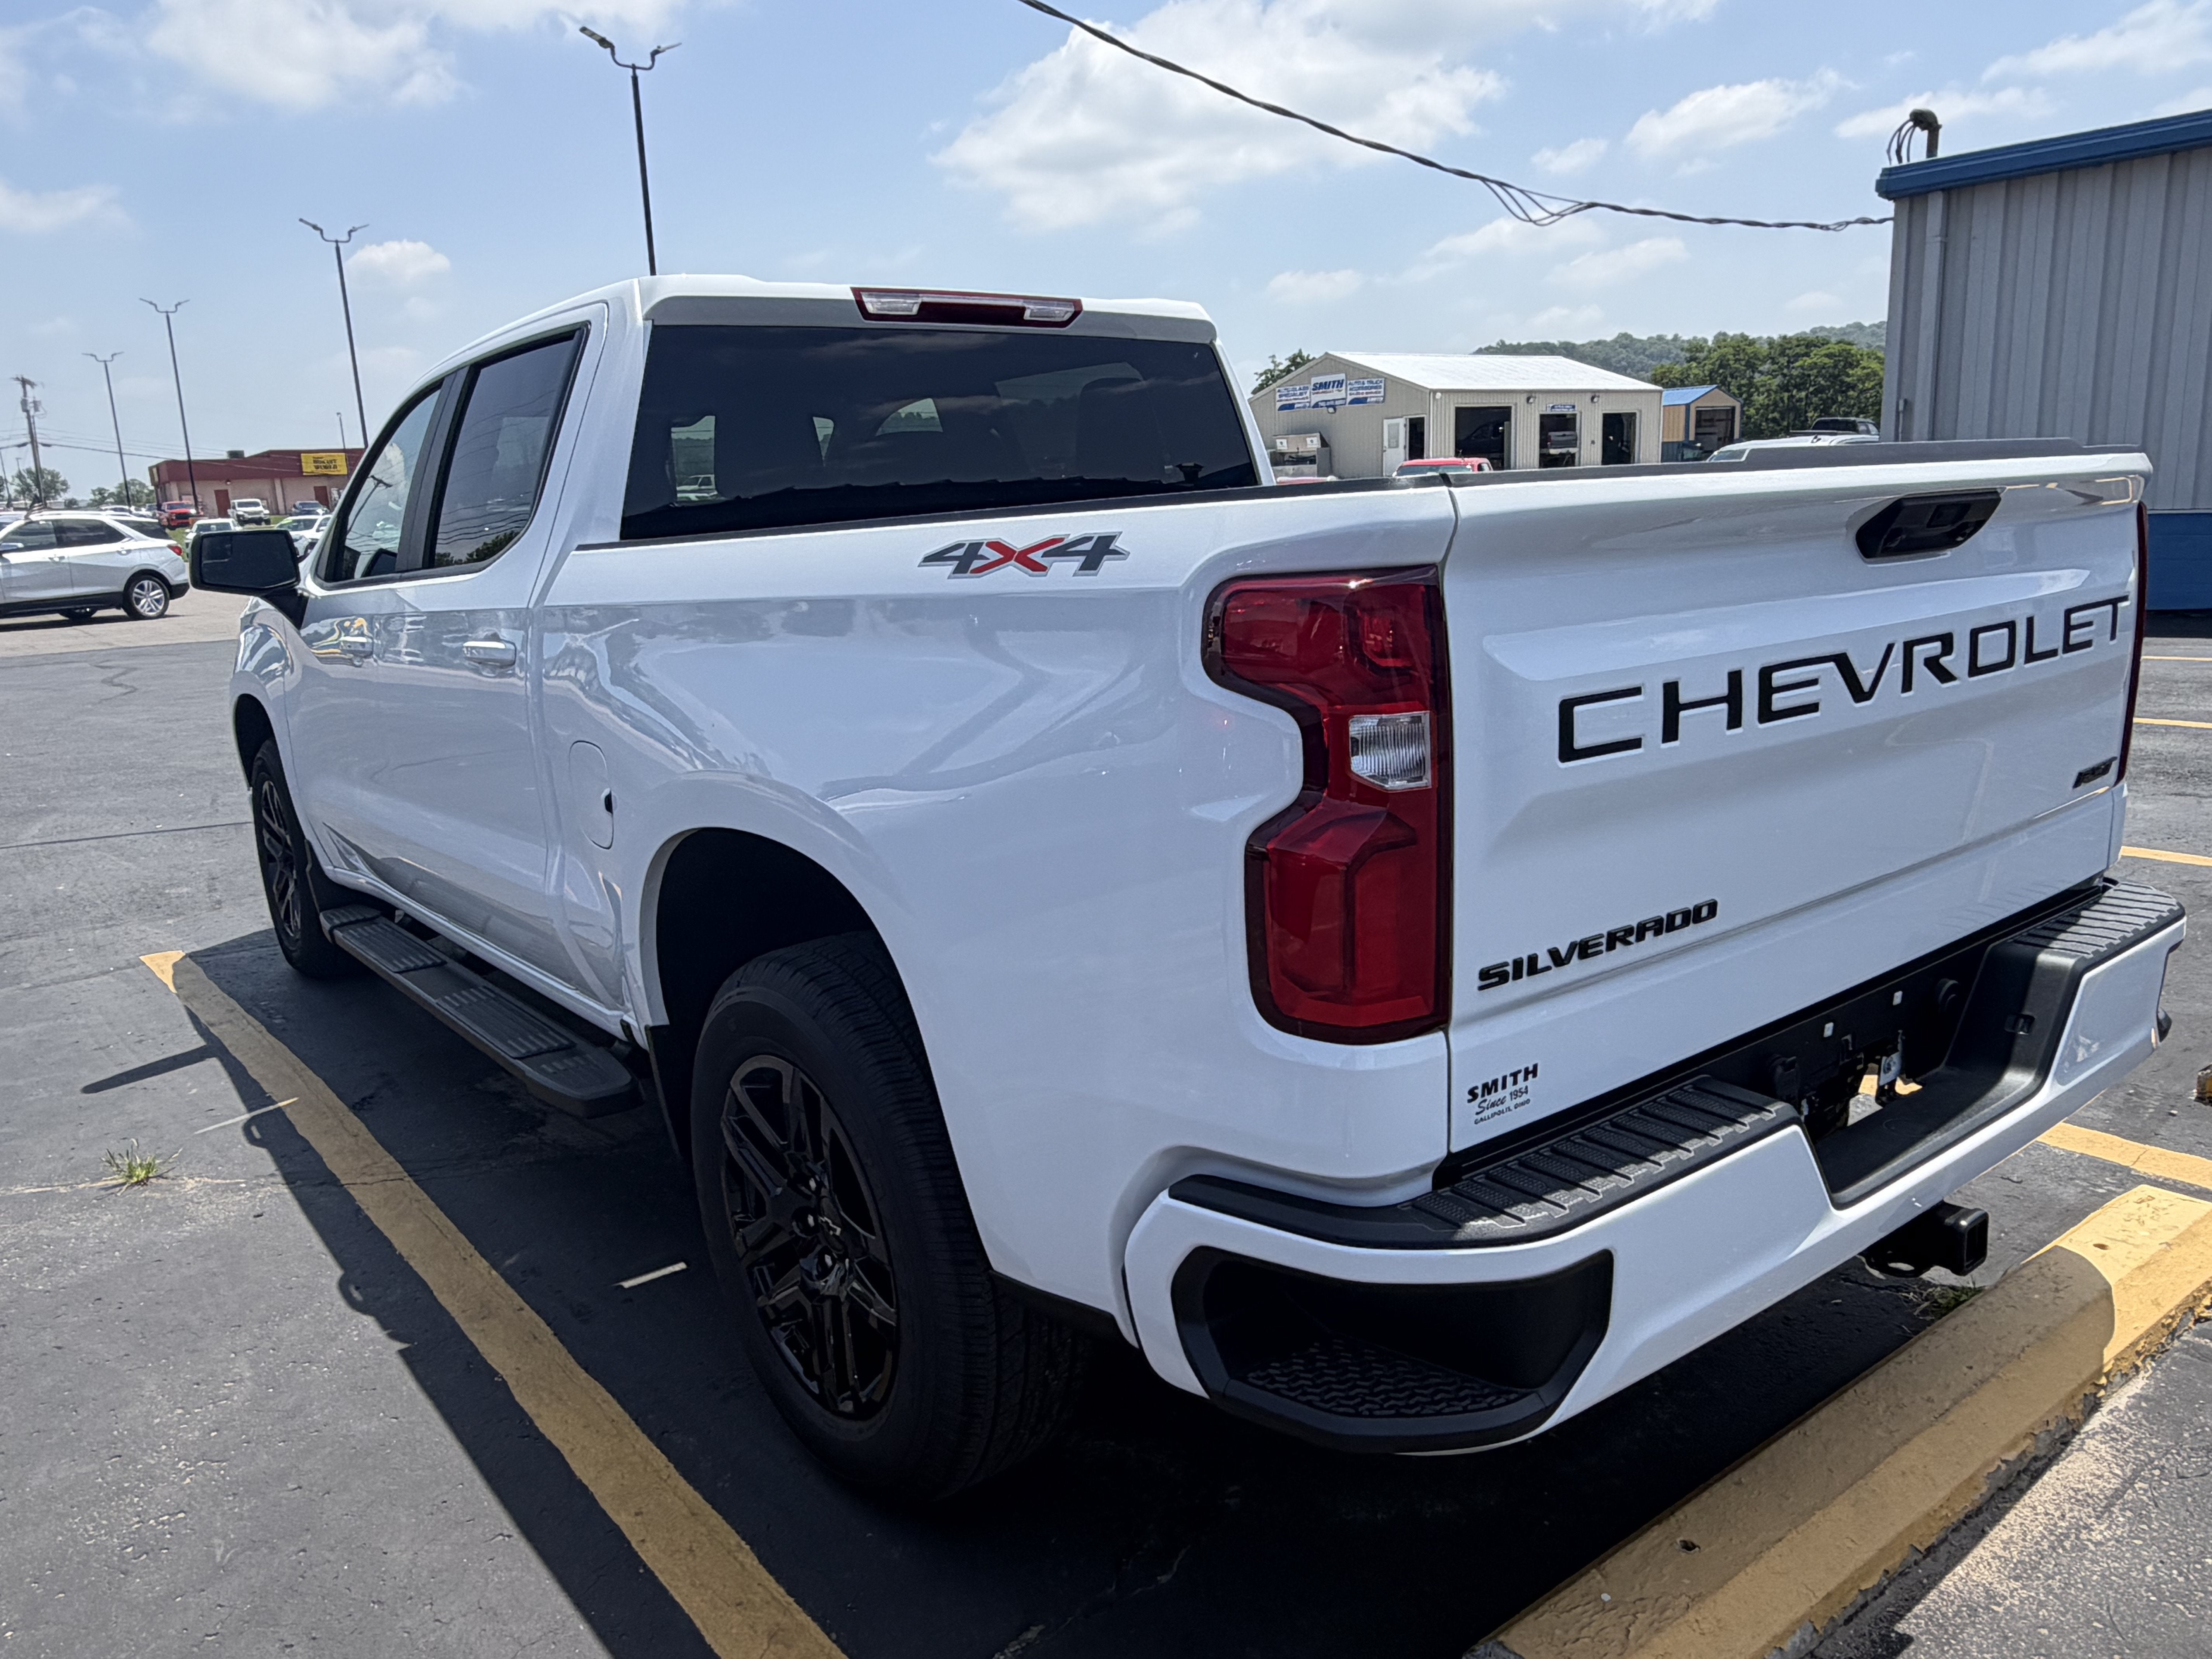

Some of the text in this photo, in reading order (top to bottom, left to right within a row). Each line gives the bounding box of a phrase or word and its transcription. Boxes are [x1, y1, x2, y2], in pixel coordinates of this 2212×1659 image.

[1312, 379, 1345, 391] SMITH
[917, 531, 1130, 579] 4X4
[1558, 595, 2130, 764] CHEVROLET
[1478, 899, 1718, 991] SILVERADO
[1467, 1063, 1538, 1103] SMITH
[1475, 1085, 1528, 1115] Since 1954
[1514, 1098, 1530, 1109] OHIO
